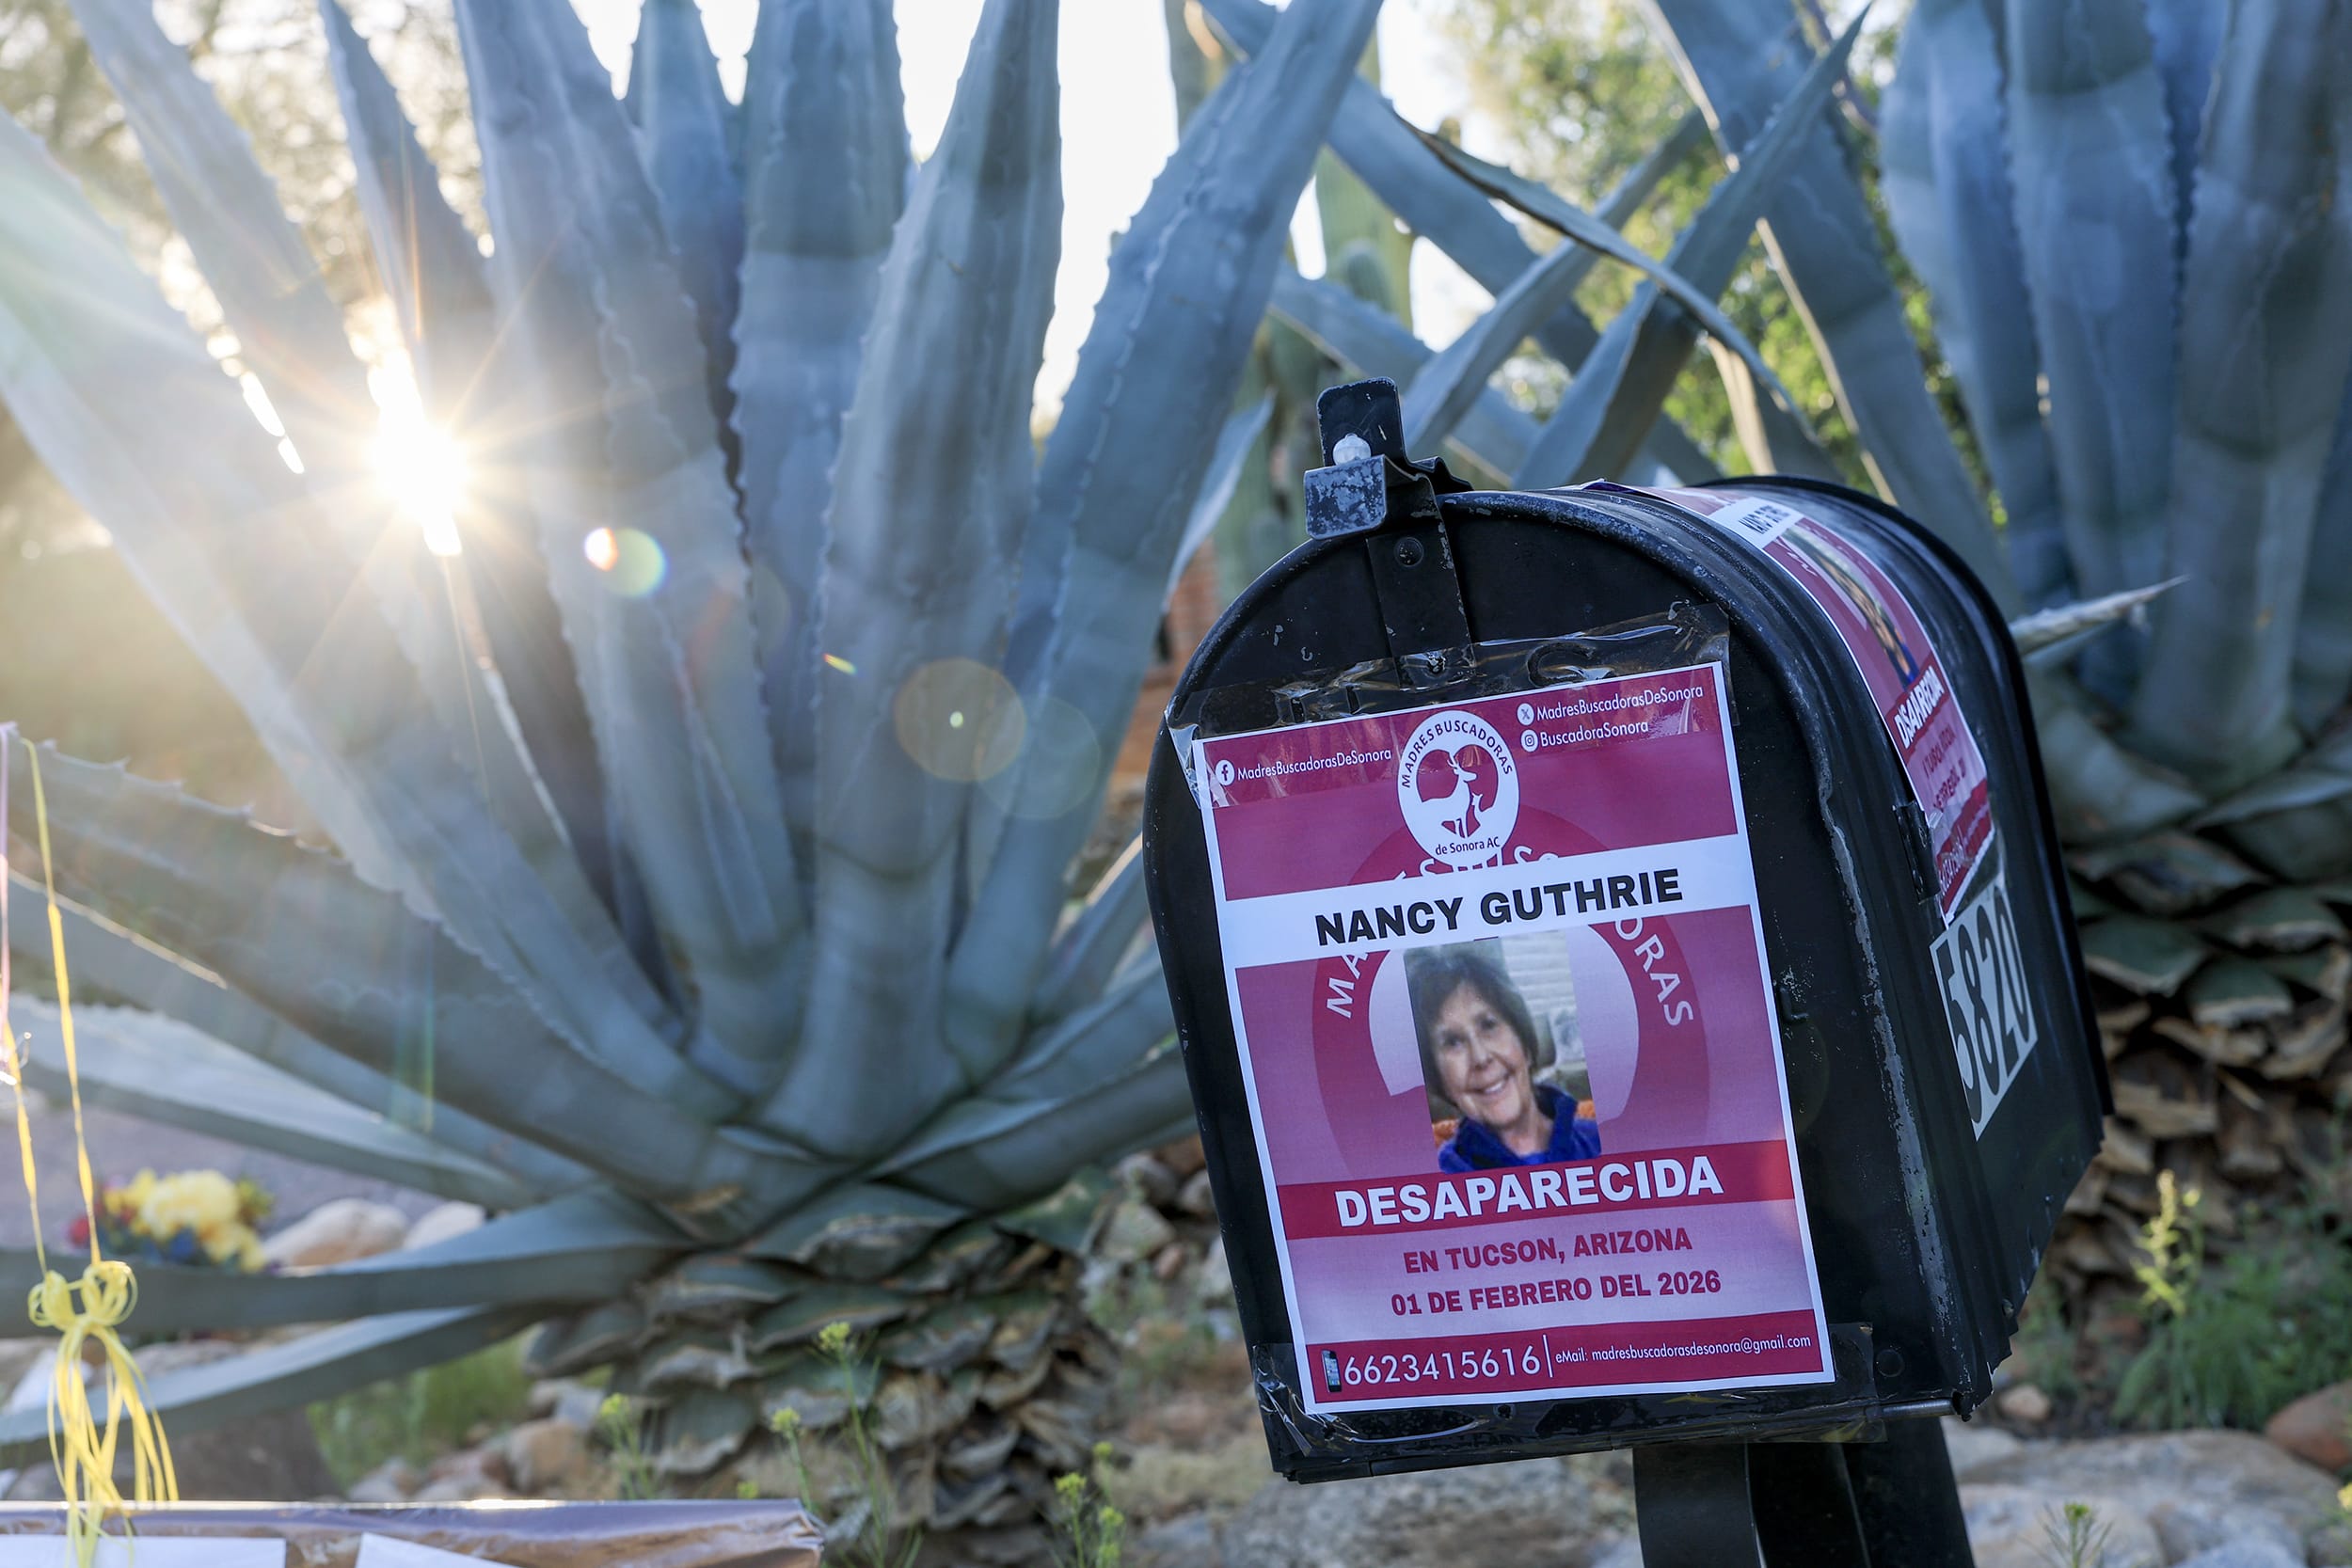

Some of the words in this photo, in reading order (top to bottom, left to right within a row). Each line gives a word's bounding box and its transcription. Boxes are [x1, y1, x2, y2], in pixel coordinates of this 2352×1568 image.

[1536, 686, 1703, 721] MadresBuscadorasDeSonora
[1540, 721, 1648, 748] BuscadoraSonora
[1237, 749, 1391, 781] MadresBuscadorasDeSonora
[1435, 843, 1448, 856] de
[1450, 840, 1485, 854] Sonora
[1486, 836, 1501, 847] AC
[1314, 896, 1464, 946] NANCY
[1479, 868, 1683, 926] GUTHRIE
[1935, 885, 2030, 1124] 5820
[1334, 1155, 1724, 1227] DESAPARECIDA
[1403, 1250, 1439, 1275] EN
[1445, 1237, 1565, 1270] TUCSON,
[1572, 1227, 1693, 1258] ARIZONA
[1391, 1292, 1422, 1317] 01
[1427, 1290, 1463, 1313] DE
[1470, 1277, 1593, 1311] FEBRERO
[1601, 1274, 1652, 1300] DEL
[1658, 1270, 1722, 1296] 2026
[1343, 1345, 1541, 1386] 6623415616
[1555, 1347, 1588, 1364] eMail:
[1592, 1334, 1812, 1361] madresbuscadorasdesonora@gmail.com
